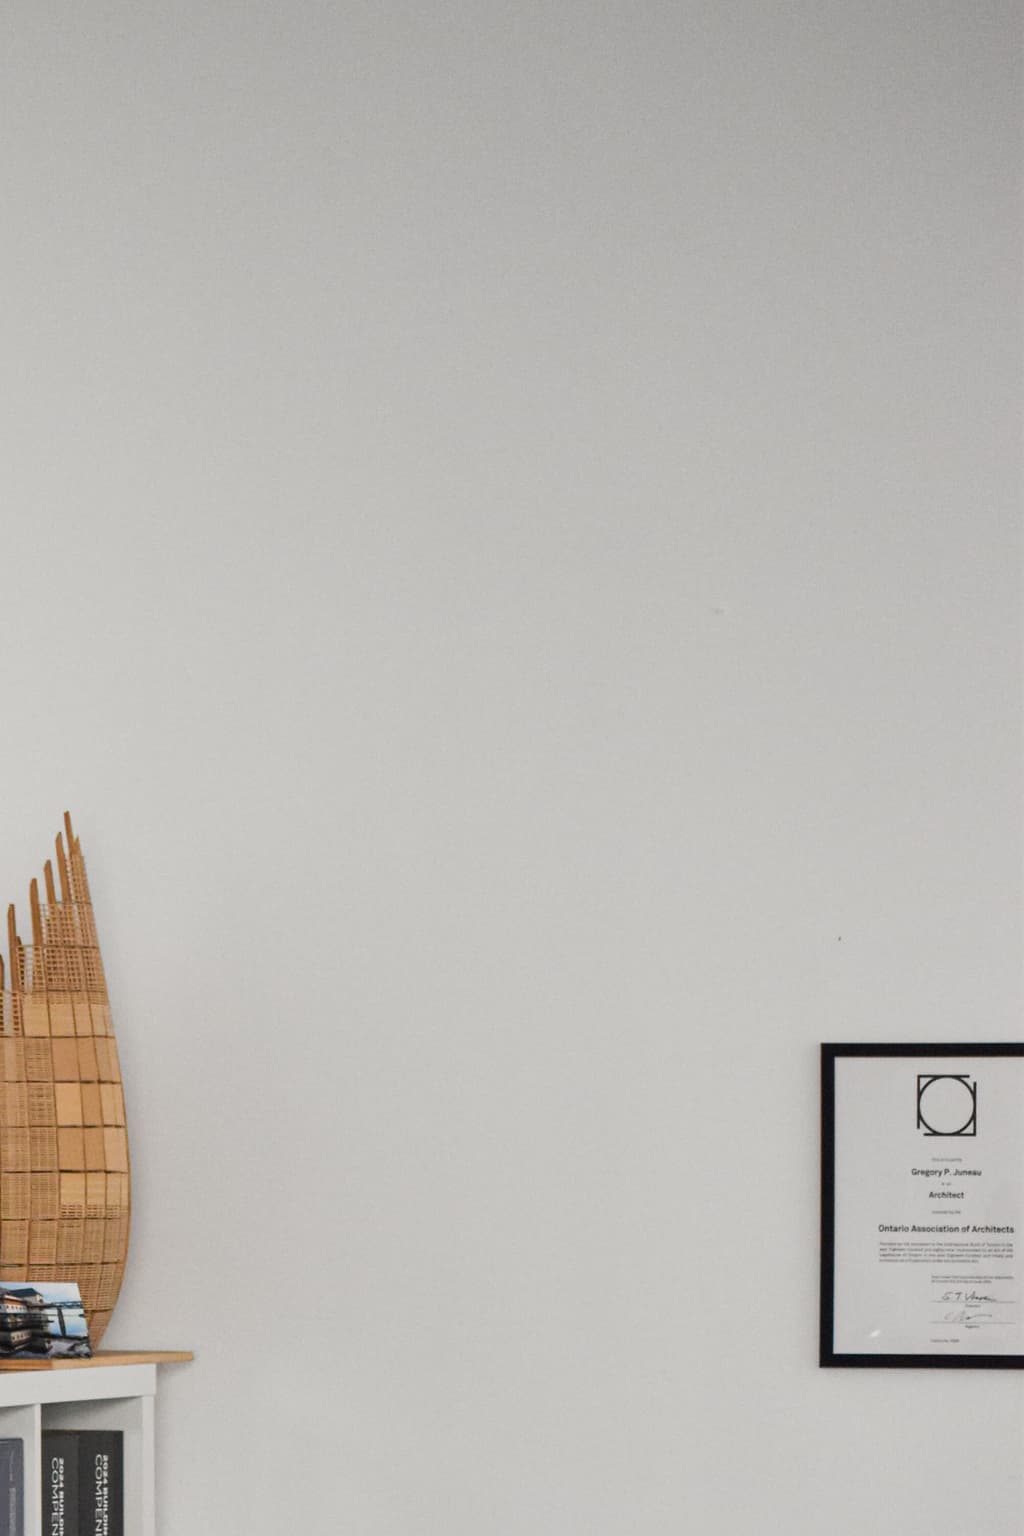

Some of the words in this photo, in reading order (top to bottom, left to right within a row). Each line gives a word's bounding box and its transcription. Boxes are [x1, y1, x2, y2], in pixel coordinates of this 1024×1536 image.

[911, 1169, 943, 1178] Gregory
[928, 1190, 965, 1199] Architect
[878, 1224, 909, 1233] Ontario
[911, 1224, 960, 1233] Association
[961, 1225, 970, 1233] of
[971, 1224, 1015, 1234] Architects
